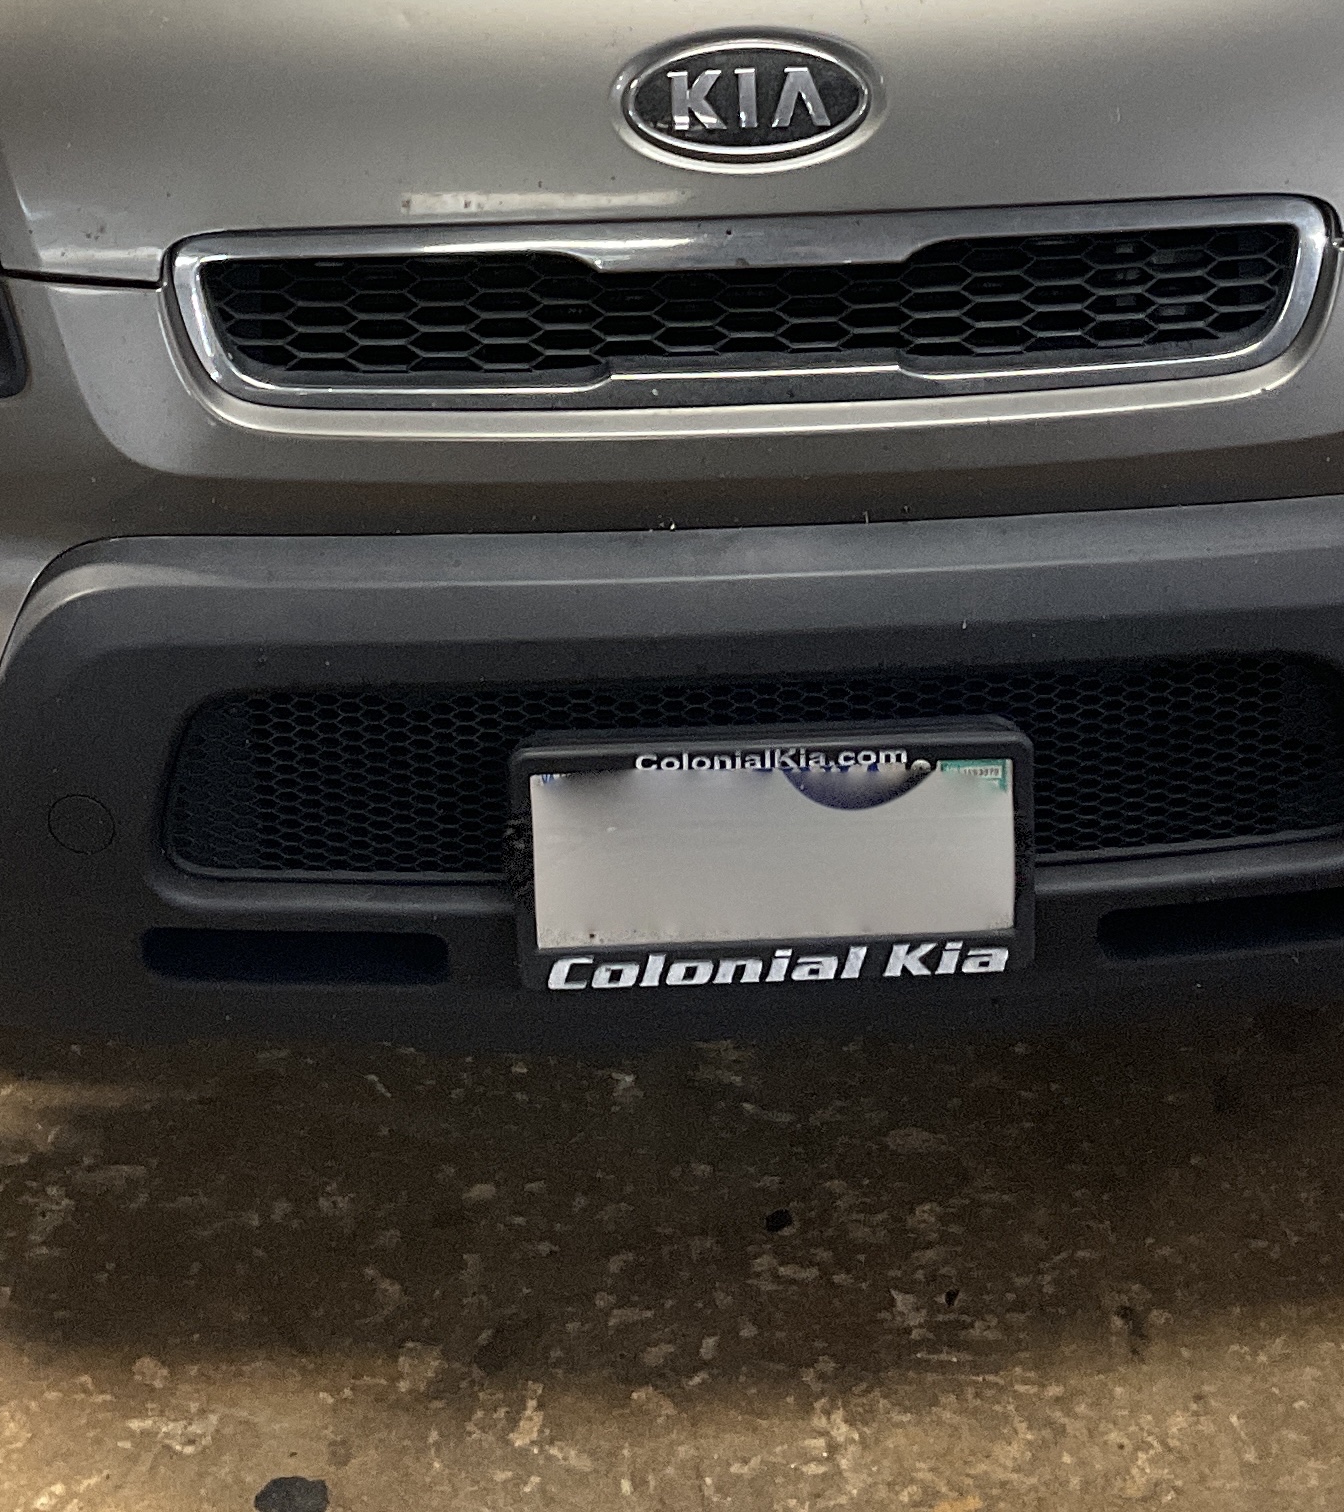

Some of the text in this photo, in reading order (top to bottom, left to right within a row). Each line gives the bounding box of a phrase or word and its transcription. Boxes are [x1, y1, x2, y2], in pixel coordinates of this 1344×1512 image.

[666, 66, 832, 132] KIA
[634, 748, 908, 772] ColonialKia.com
[547, 941, 1010, 989] Colonial Kia
